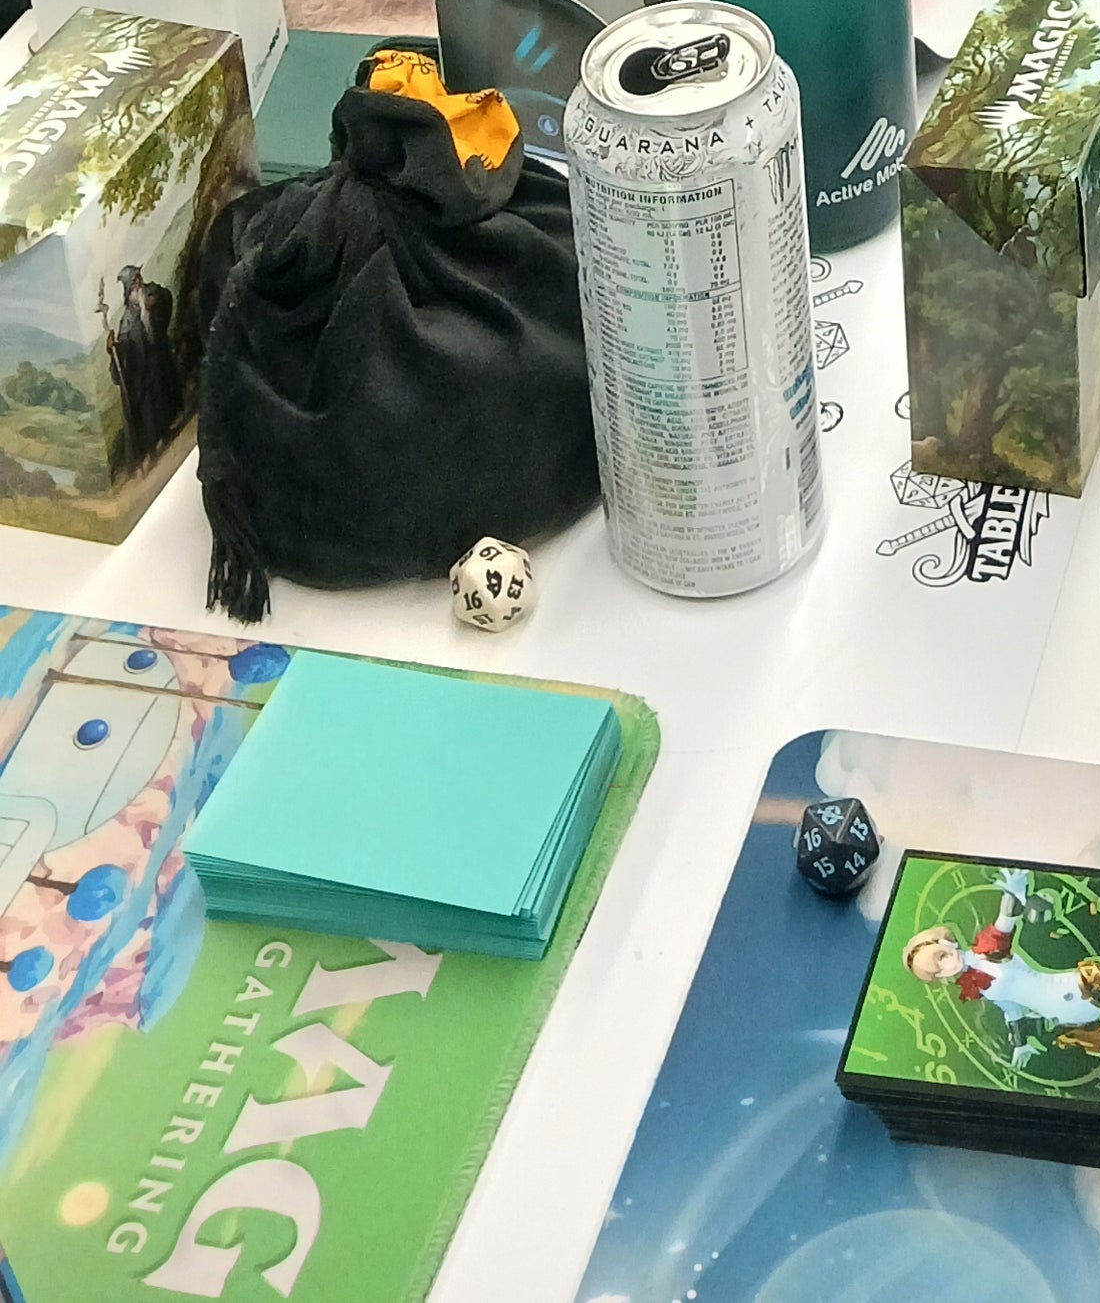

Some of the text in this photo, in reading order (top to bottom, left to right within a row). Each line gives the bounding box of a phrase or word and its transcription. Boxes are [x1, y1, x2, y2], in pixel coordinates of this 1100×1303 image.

[1006, 0, 1079, 104] MAGIC
[584, 116, 725, 155] GUARANA
[639, 186, 723, 204] INFORMATION
[816, 178, 874, 207] Active
[463, 590, 484, 611] 16
[803, 827, 822, 852] 16
[849, 816, 869, 841] 13
[813, 856, 836, 879] 15
[844, 851, 866, 875] 14
[106, 940, 294, 1257] GATHERING
